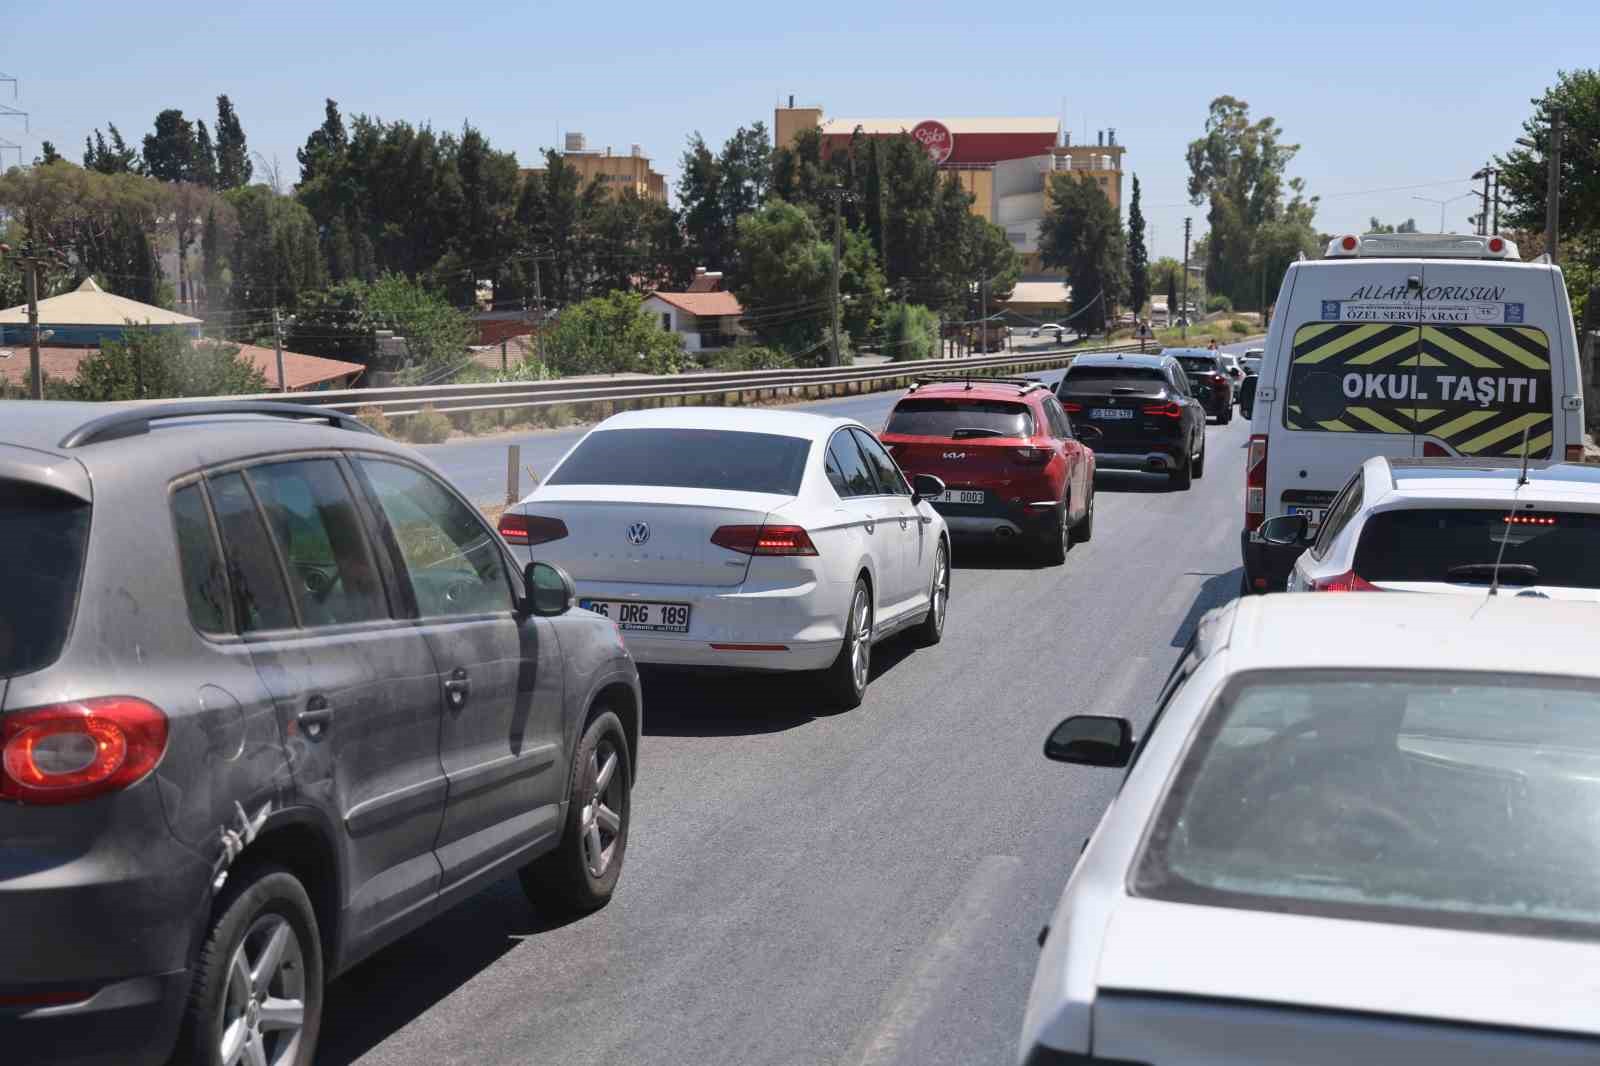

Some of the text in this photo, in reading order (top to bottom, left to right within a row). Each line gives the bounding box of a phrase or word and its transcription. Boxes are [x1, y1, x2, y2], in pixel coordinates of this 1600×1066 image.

[1351, 286, 1408, 300] ALLAH
[1342, 373, 1537, 407] OKUL TAŞITI
[620, 605, 649, 622] DRG
[661, 606, 687, 624] 189
